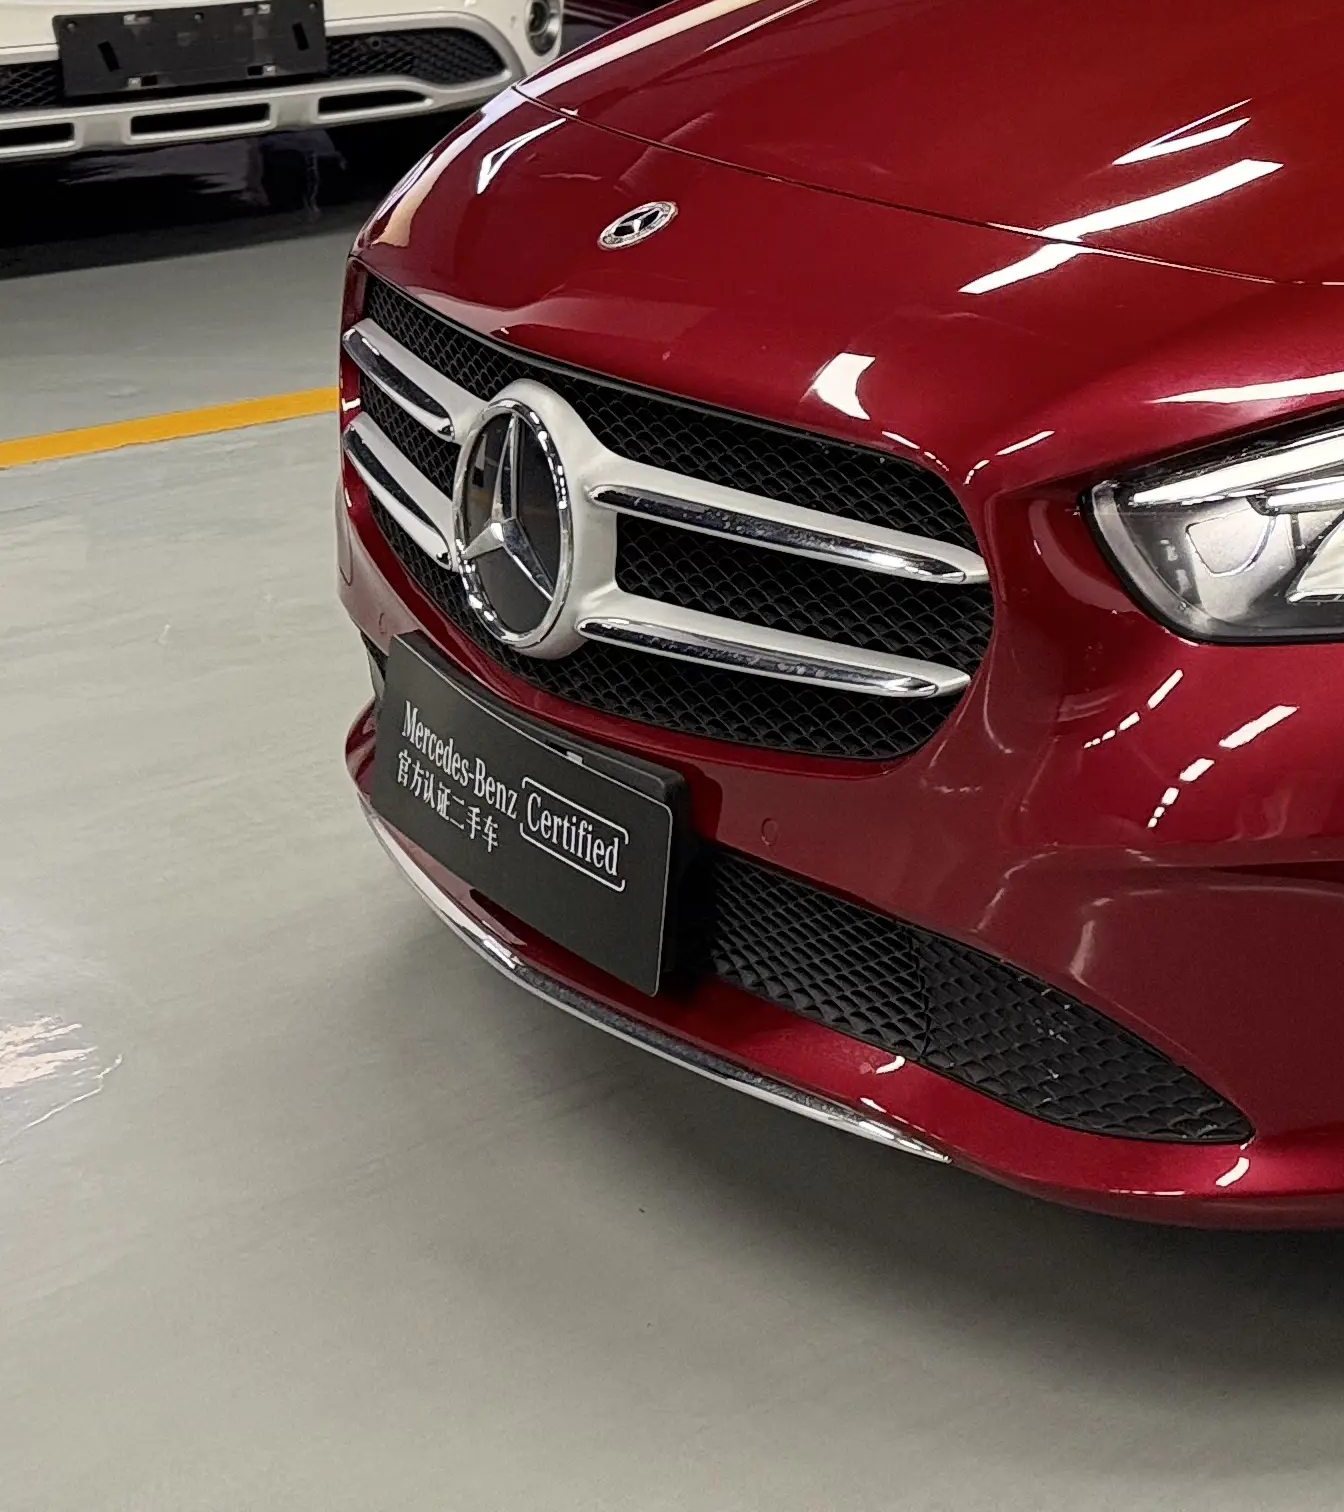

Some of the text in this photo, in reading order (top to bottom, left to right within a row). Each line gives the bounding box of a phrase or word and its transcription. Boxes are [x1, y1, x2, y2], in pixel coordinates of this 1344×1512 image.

[397, 750, 500, 853] 官方认证二手车
[401, 700, 620, 877] Mercedes-Benz Certified
